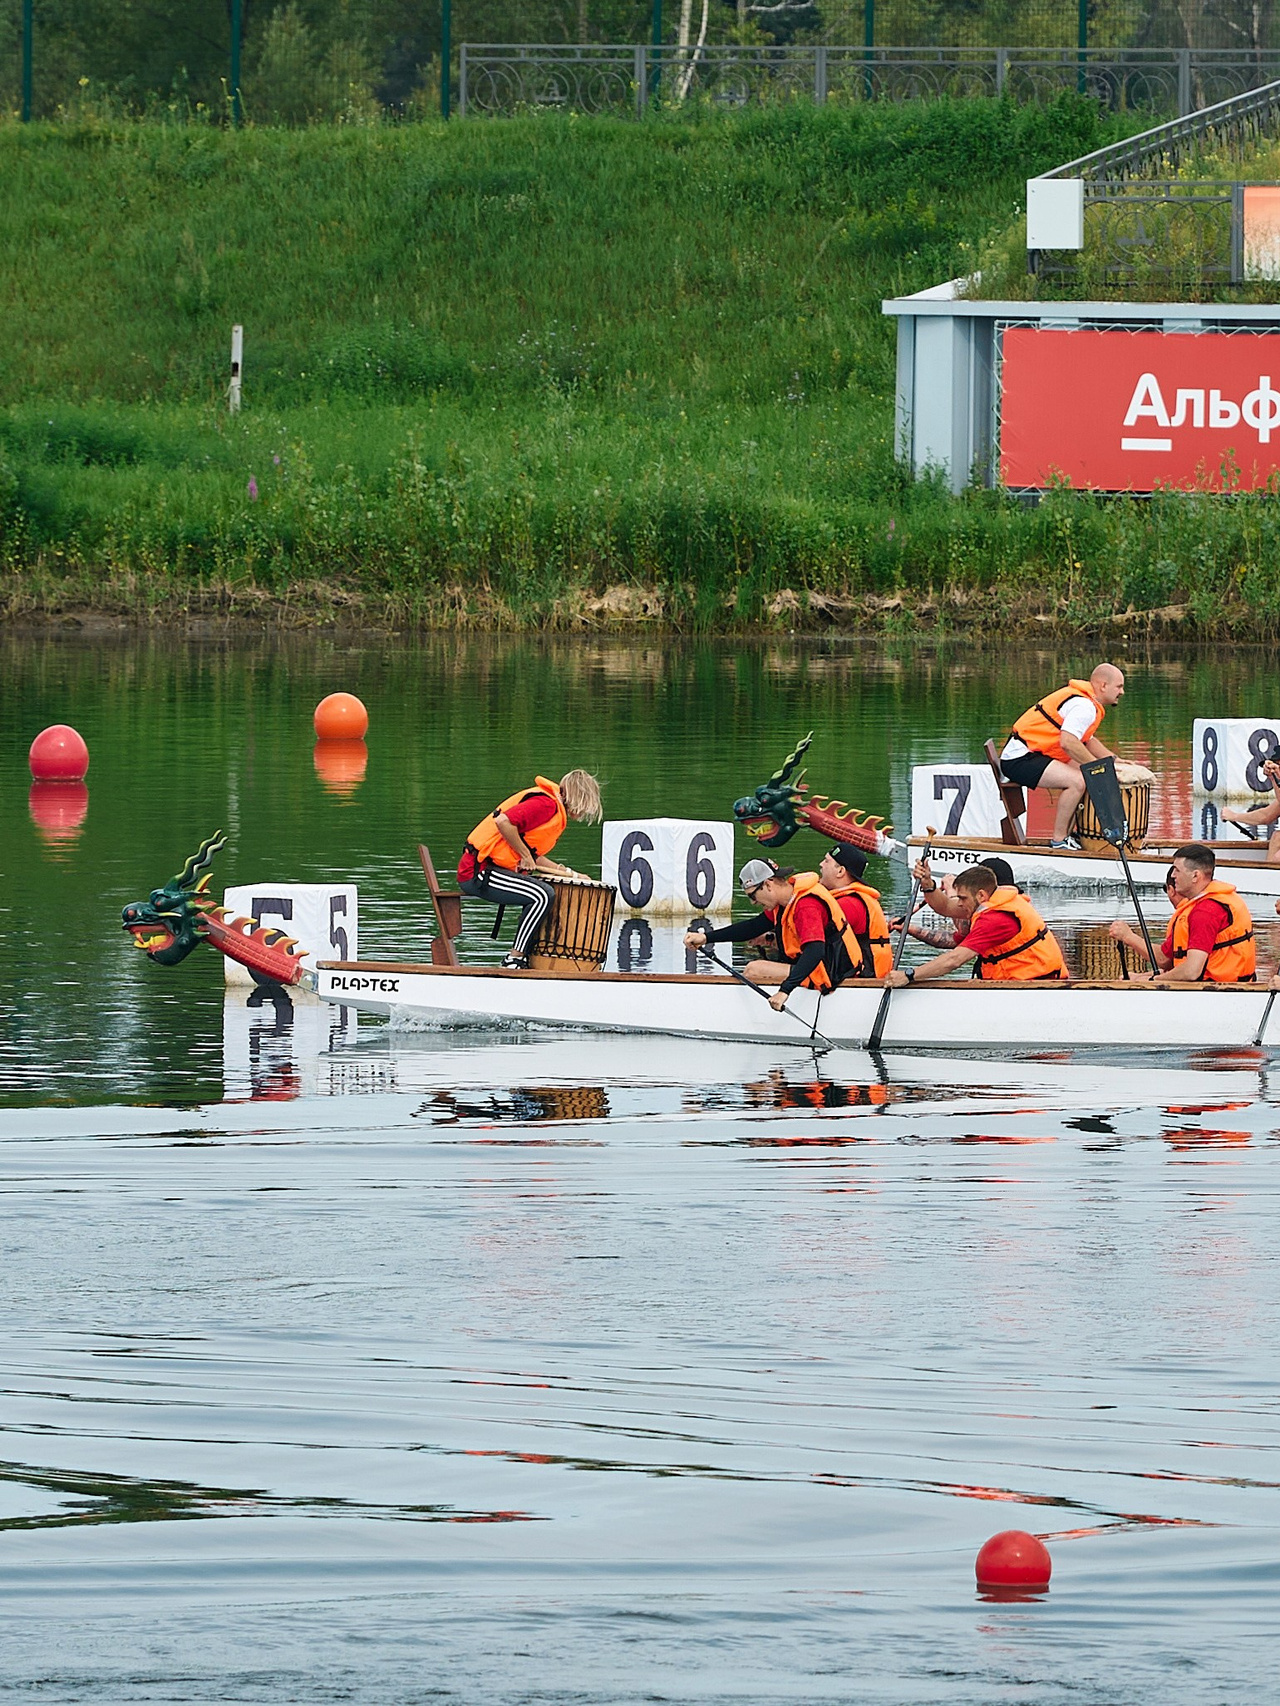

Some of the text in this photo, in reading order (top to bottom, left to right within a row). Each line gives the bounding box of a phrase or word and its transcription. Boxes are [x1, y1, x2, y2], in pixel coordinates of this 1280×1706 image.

[1202, 727, 1218, 792] 8
[1246, 728, 1279, 792] 8
[933, 774, 971, 835] 7
[618, 831, 654, 909] 6
[686, 832, 716, 909] 6
[330, 894, 348, 962] 5
